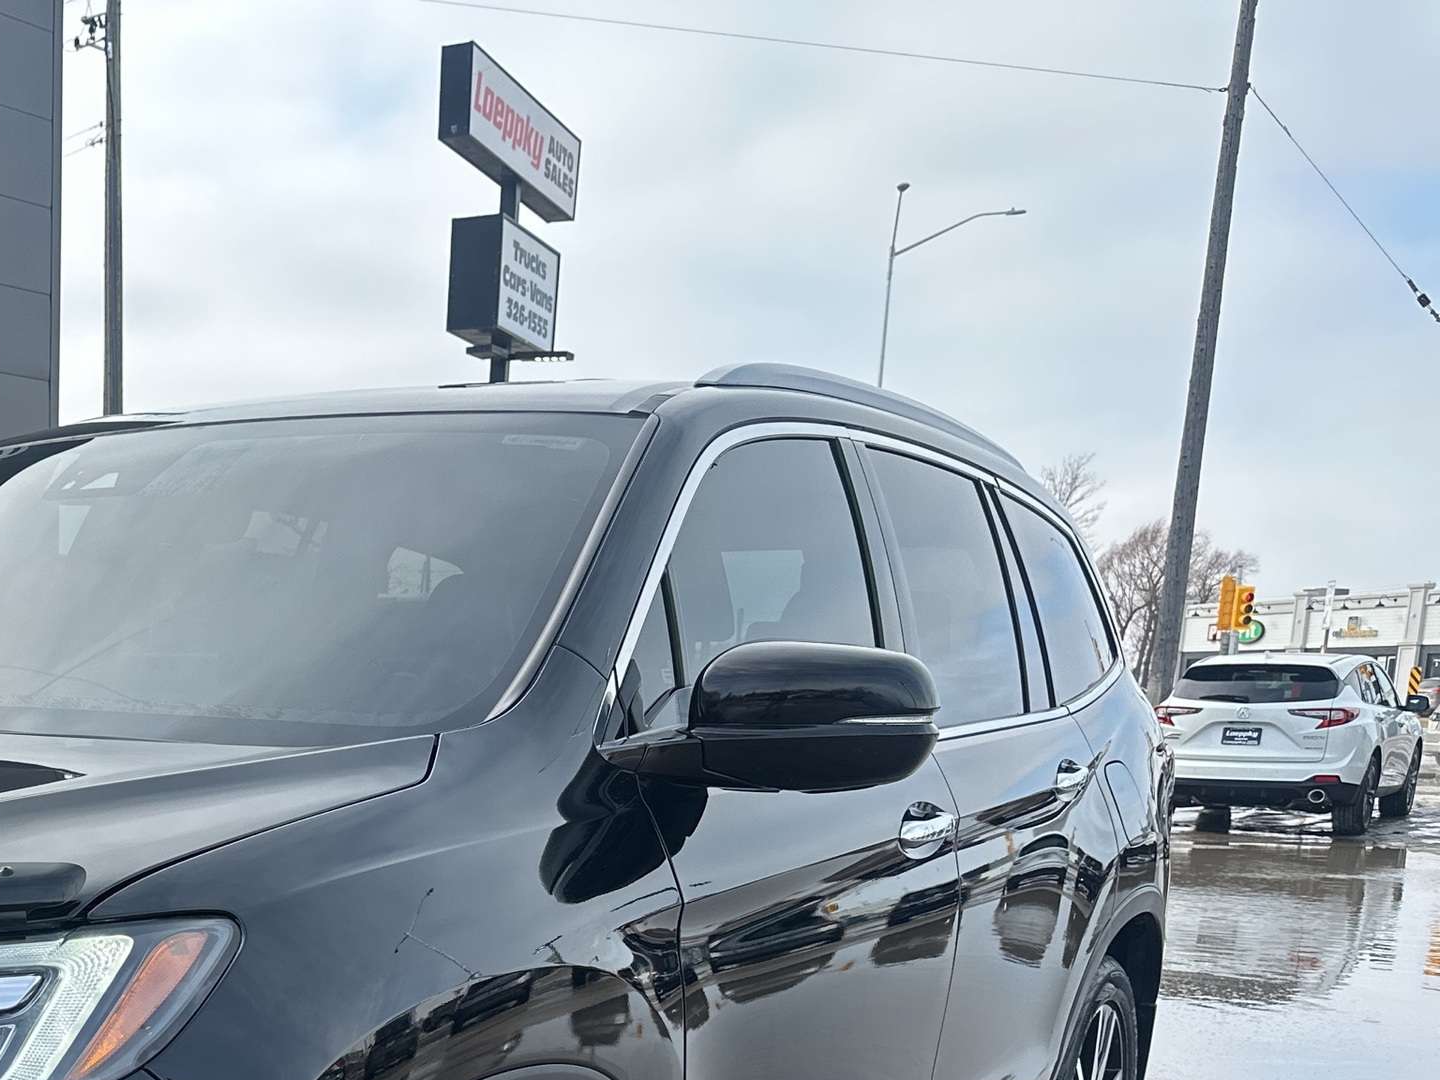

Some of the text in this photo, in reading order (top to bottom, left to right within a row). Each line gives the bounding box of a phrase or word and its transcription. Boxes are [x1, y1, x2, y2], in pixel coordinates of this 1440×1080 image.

[473, 70, 545, 171] Loeppky
[548, 135, 575, 173] AUTO
[544, 159, 574, 199] SALES
[513, 239, 547, 280] Trucks
